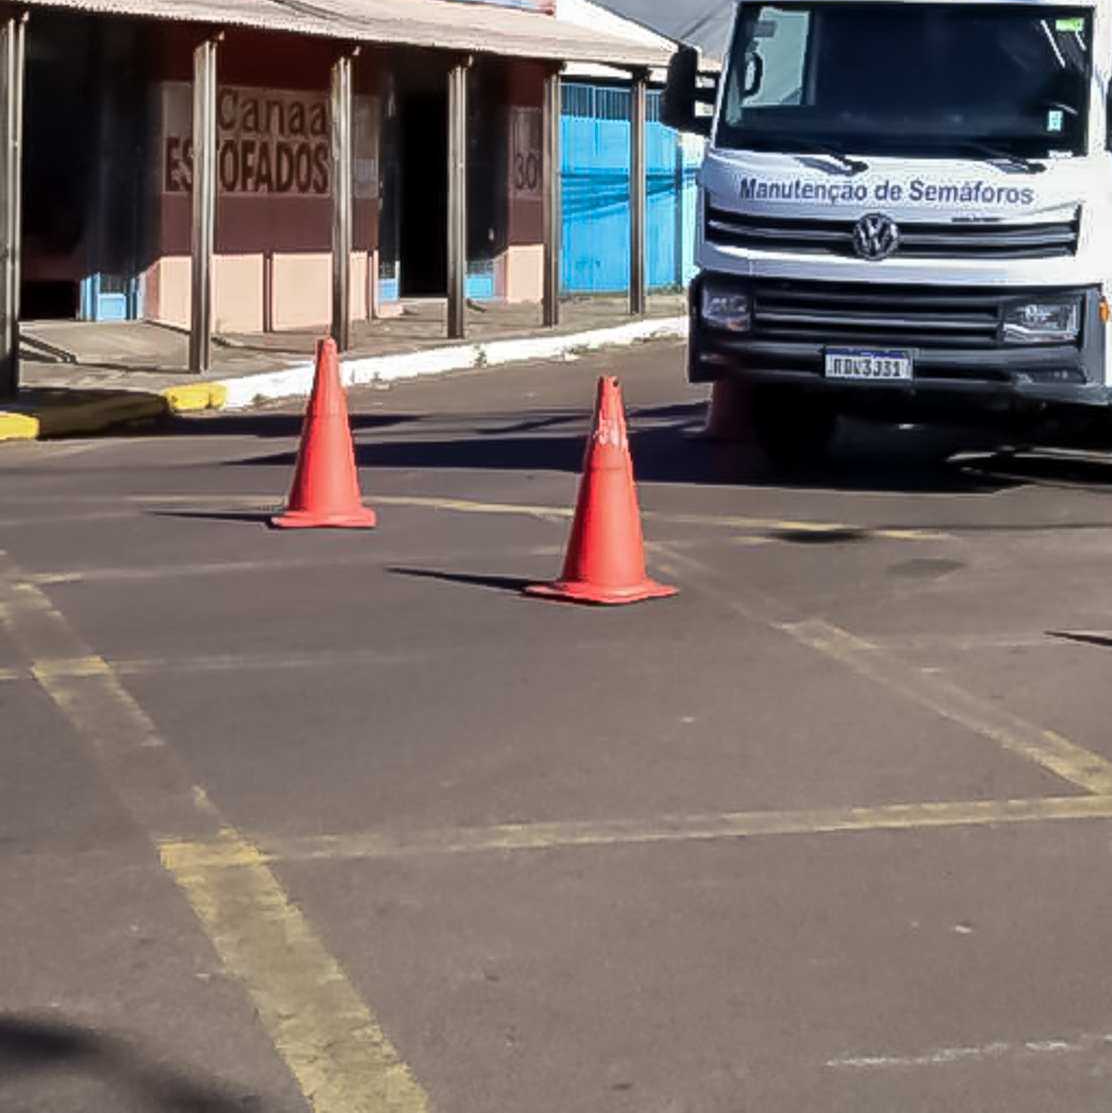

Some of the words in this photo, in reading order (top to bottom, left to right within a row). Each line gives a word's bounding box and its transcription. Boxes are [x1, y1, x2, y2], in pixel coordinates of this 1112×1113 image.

[165, 138, 330, 193] ESOFADOS
[739, 178, 867, 204] Manutenção
[875, 179, 902, 201] de
[908, 179, 1034, 205] Semáforos
